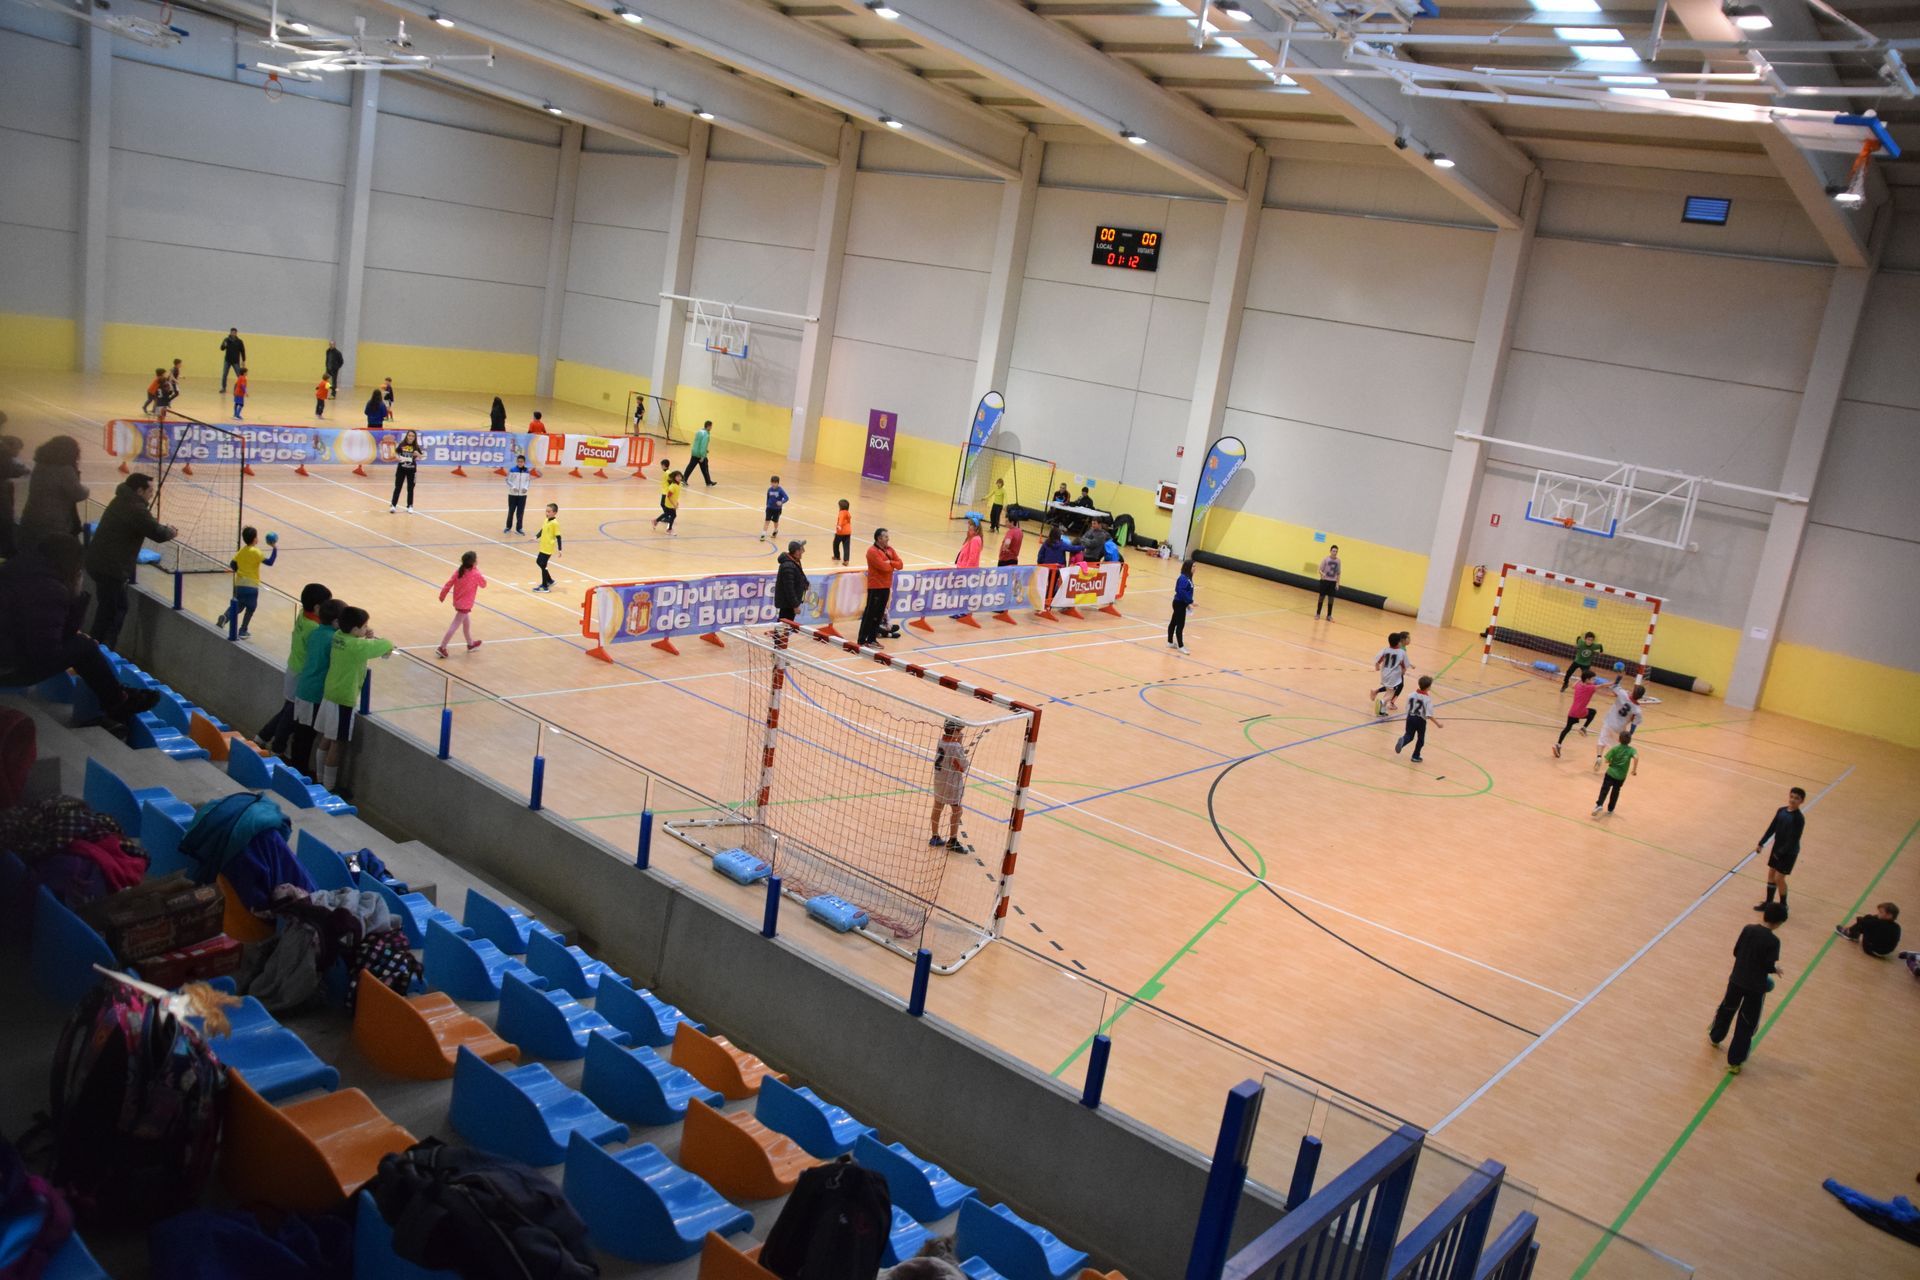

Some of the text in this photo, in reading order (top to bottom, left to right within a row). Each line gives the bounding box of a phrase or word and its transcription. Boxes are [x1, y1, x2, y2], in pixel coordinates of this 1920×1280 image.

[1101, 228, 1116, 241] 00
[1142, 232, 1157, 246] 00
[1107, 252, 1140, 268] 01:12
[173, 425, 307, 446] Diputación
[870, 437, 890, 451] ROA
[176, 444, 306, 463] de Burgos
[434, 447, 504, 465] Burgos
[578, 445, 616, 459] Pascual
[896, 570, 1008, 595] Diputación
[656, 578, 777, 609] Diputació
[896, 592, 1005, 612] de Burgos
[657, 603, 780, 630] de Burgo
[1384, 653, 1398, 668] 11
